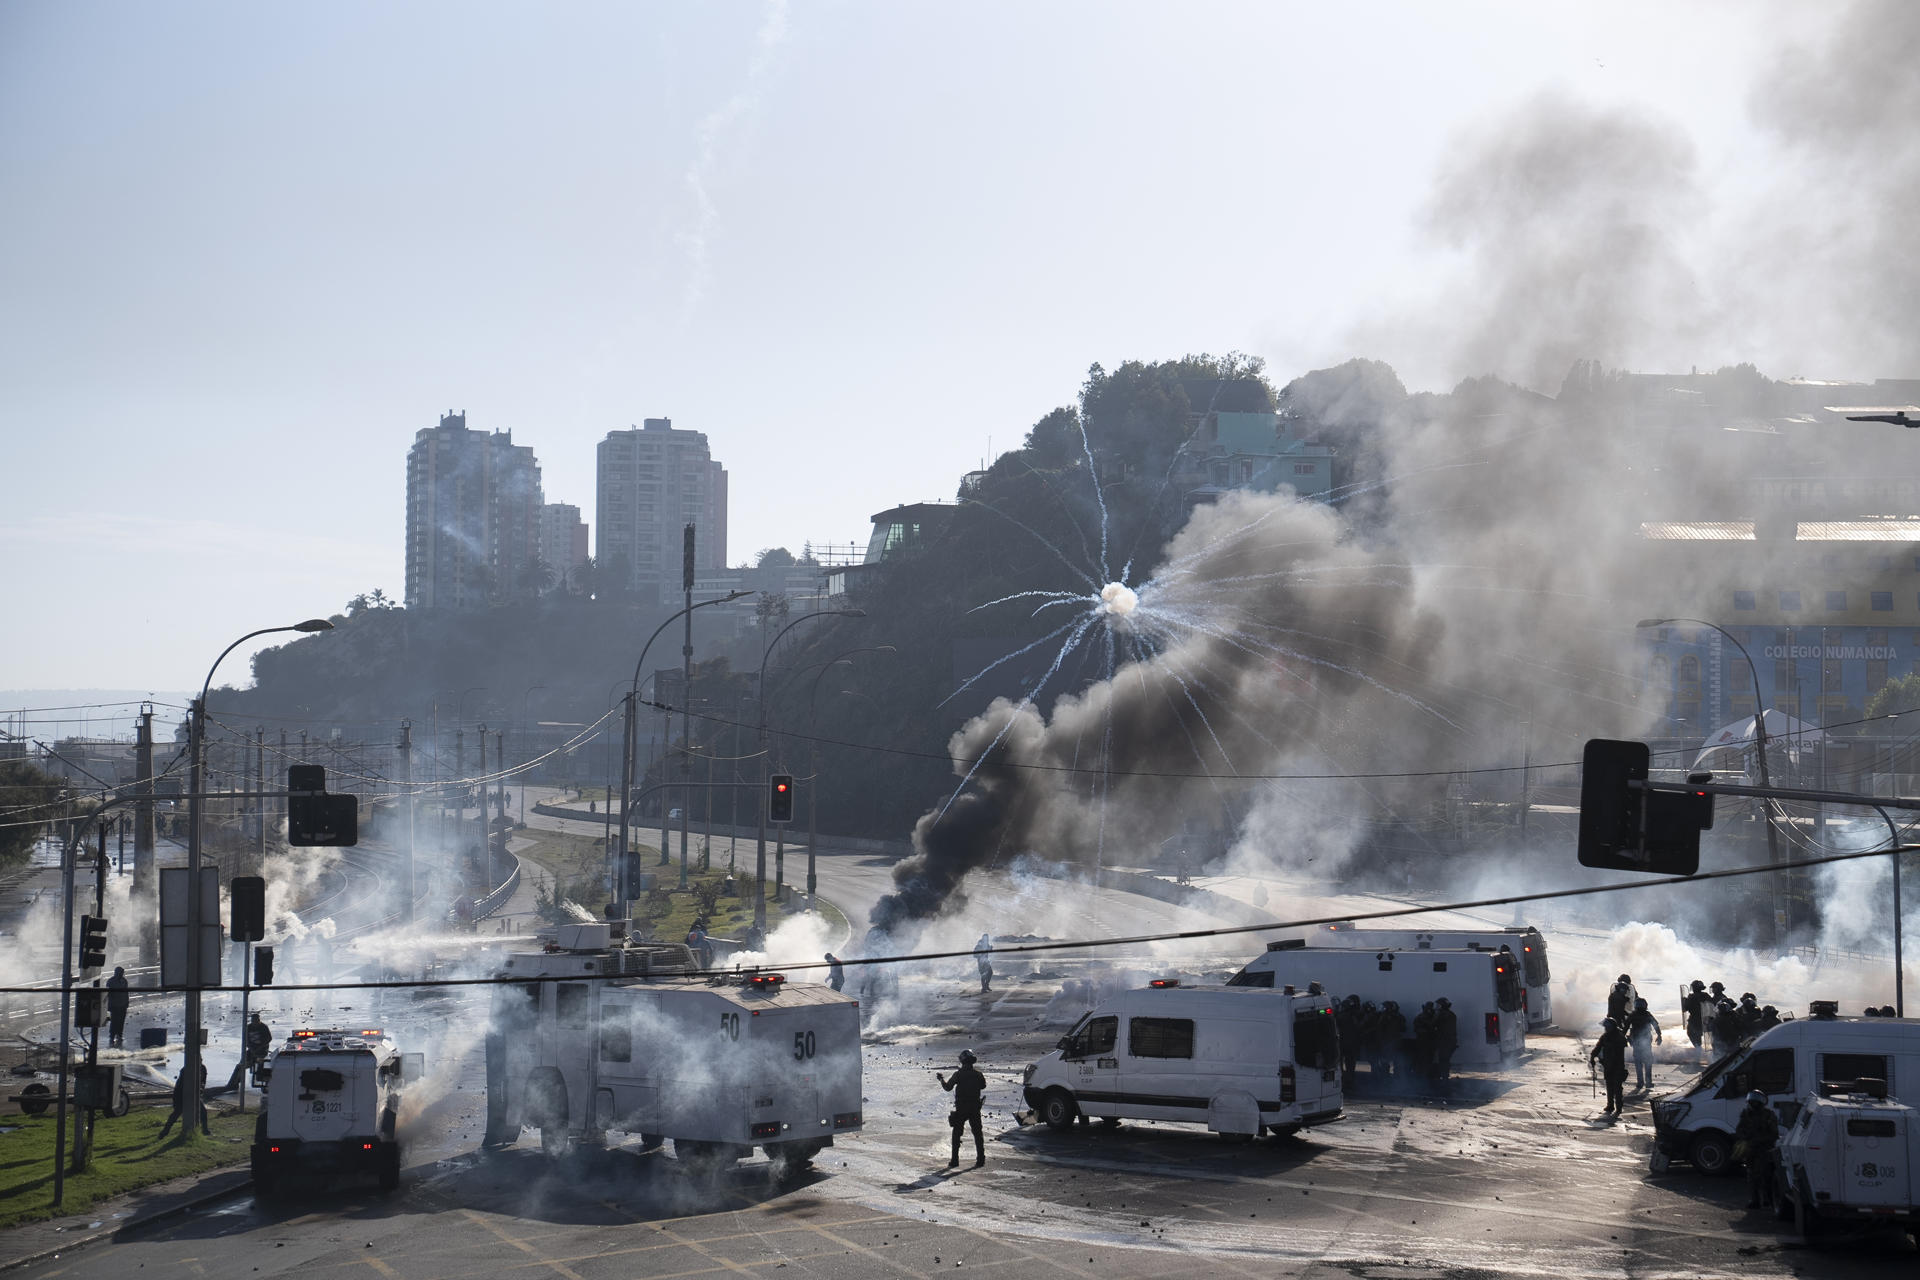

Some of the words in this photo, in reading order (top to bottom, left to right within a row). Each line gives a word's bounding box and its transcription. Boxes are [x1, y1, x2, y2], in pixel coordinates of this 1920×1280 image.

[1764, 645, 1822, 658] COLEGIO
[1826, 645, 1897, 660] NUMANCIA
[719, 1012, 740, 1042] 50
[793, 1030, 816, 1061] 50
[326, 1102, 342, 1113] 1221
